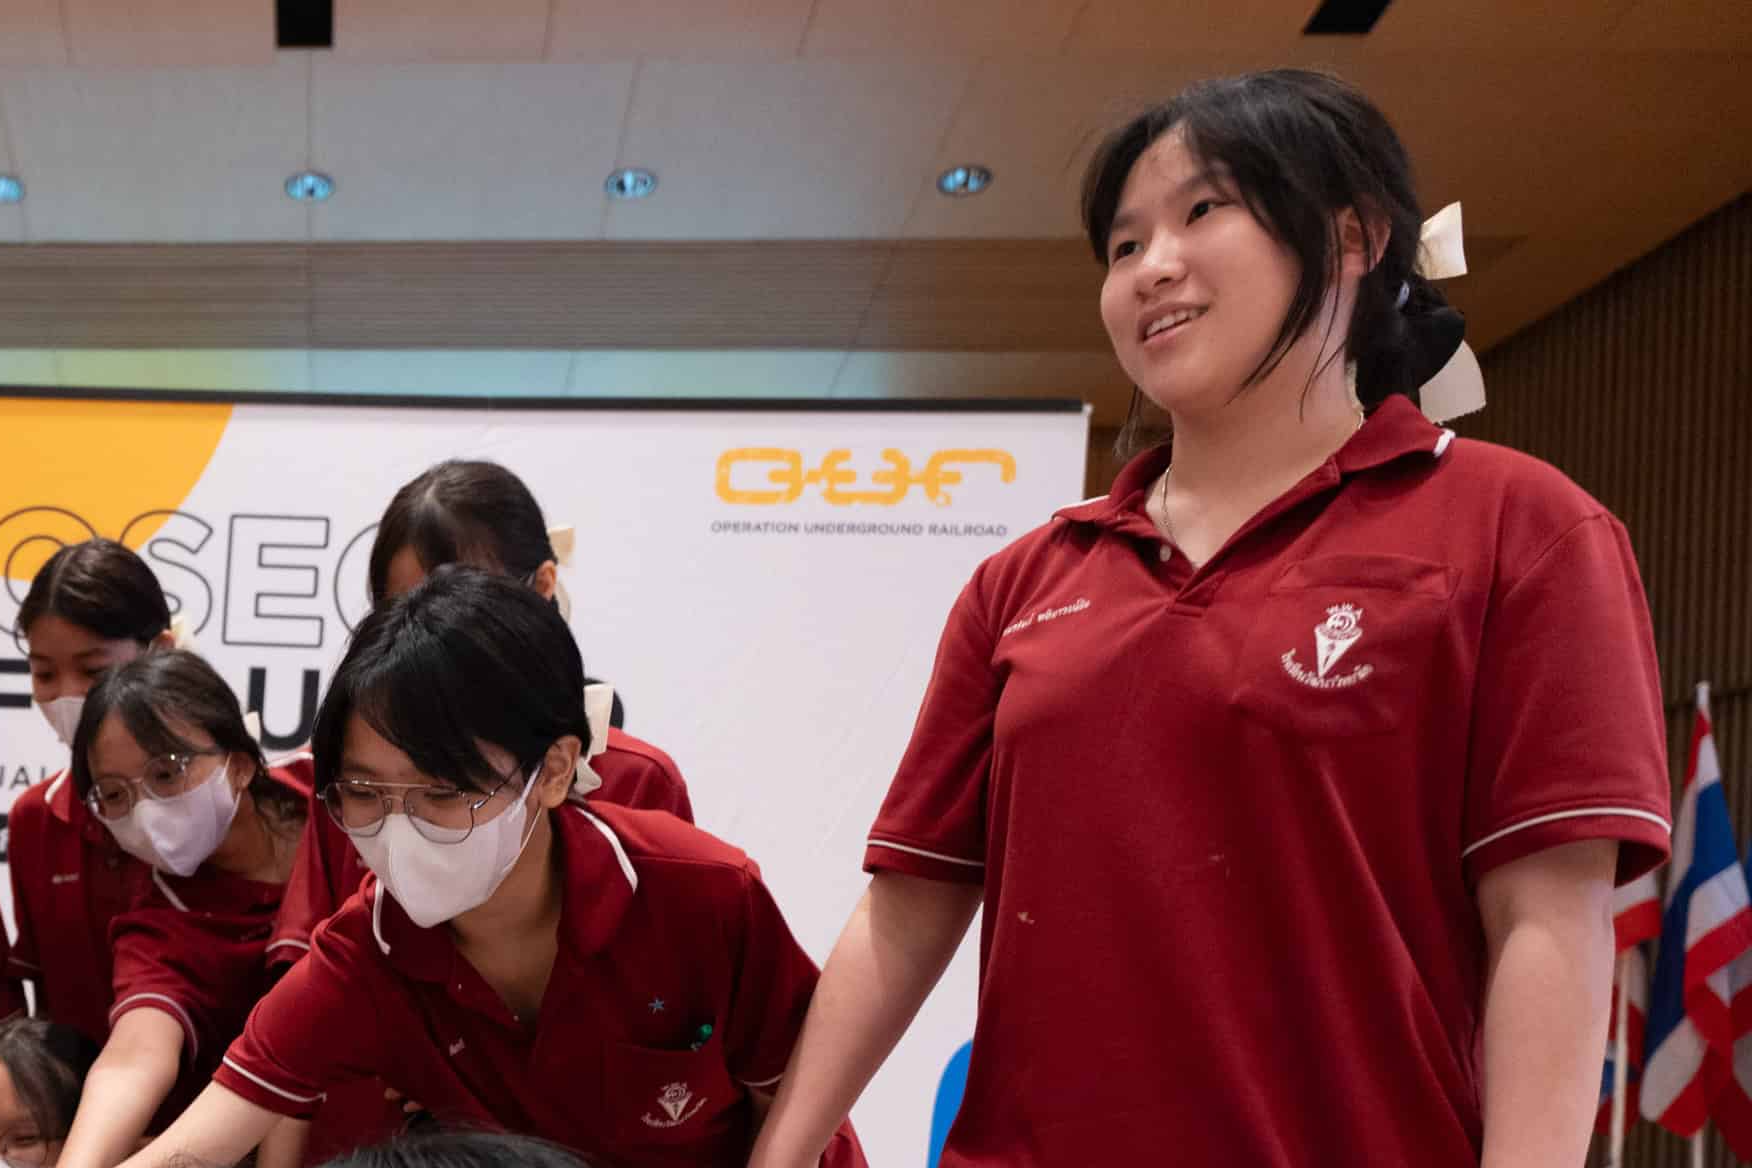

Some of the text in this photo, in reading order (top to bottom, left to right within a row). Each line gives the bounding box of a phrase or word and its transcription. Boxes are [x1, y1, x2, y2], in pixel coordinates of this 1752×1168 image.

[710, 519, 1008, 538] OPERATION UNDERGROUND RAILROAD
